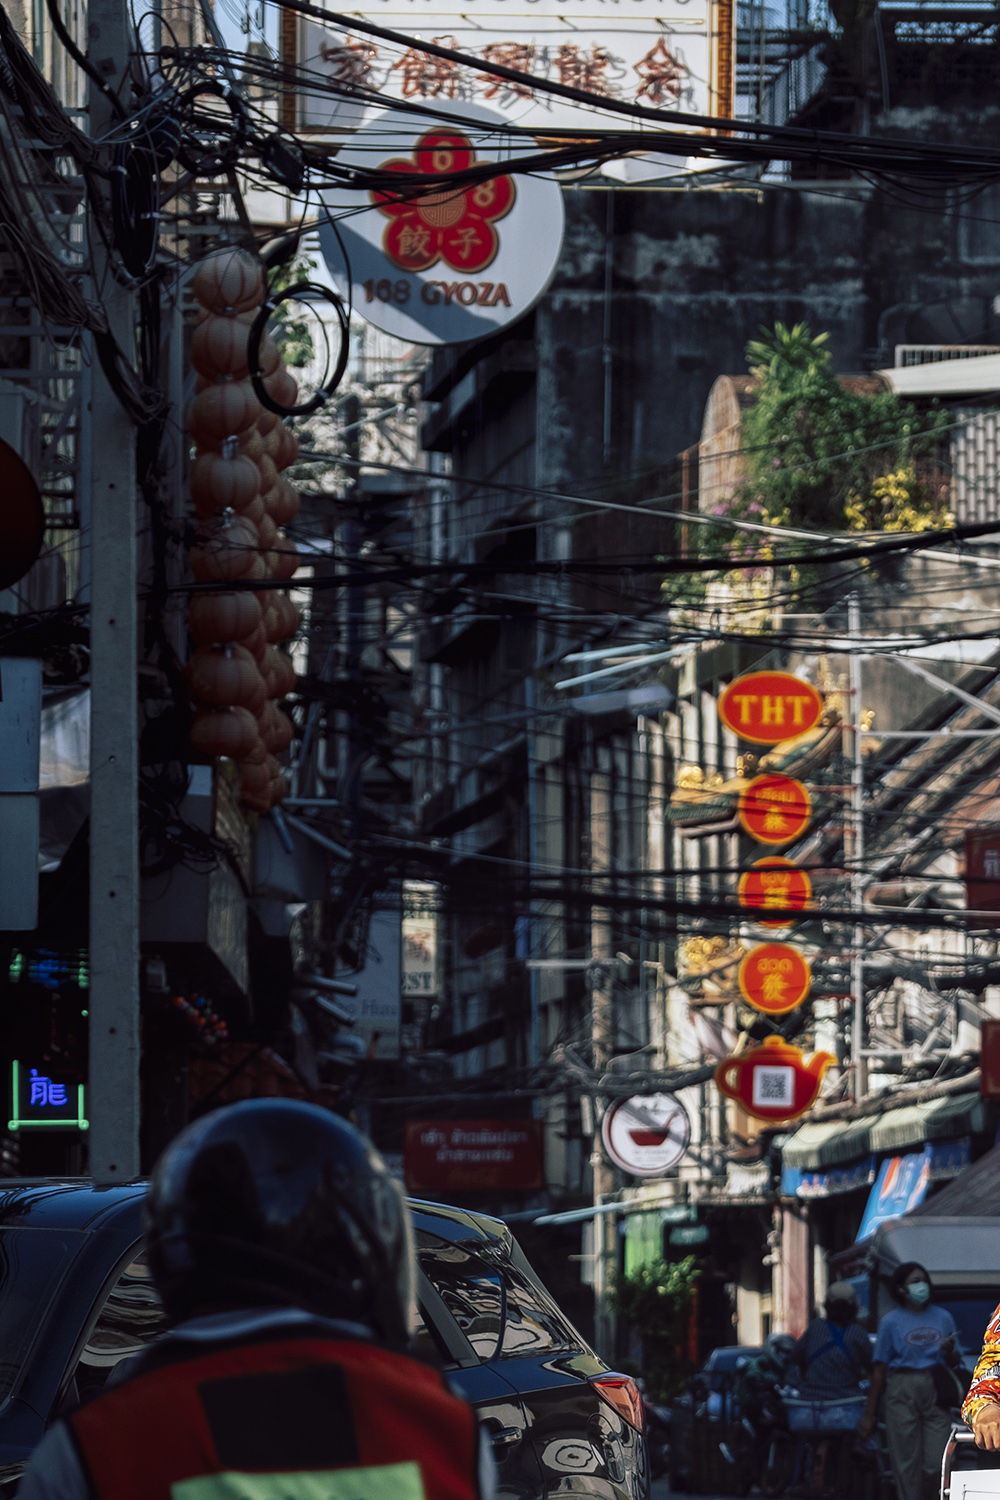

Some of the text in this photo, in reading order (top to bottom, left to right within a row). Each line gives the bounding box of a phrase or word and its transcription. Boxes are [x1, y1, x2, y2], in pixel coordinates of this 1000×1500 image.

[364, 278, 511, 307] 168 GYOZA
[732, 694, 811, 726] THT
